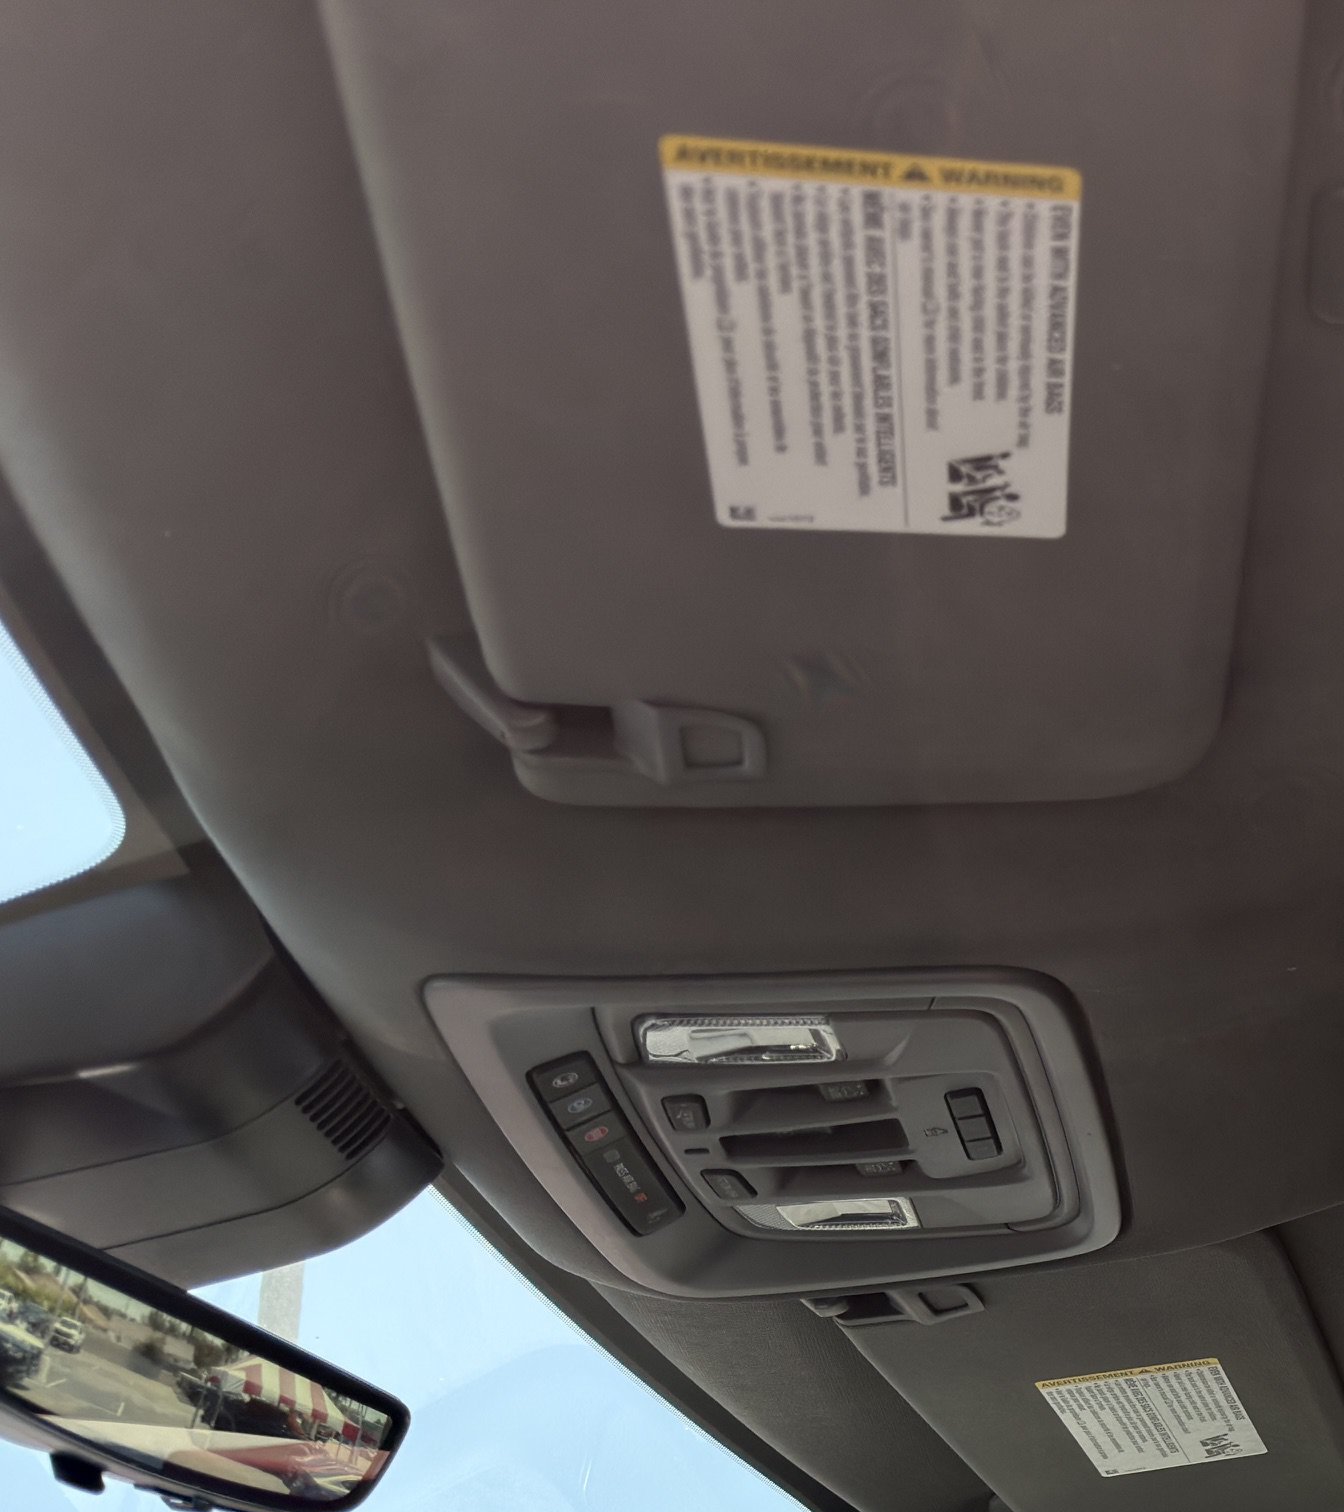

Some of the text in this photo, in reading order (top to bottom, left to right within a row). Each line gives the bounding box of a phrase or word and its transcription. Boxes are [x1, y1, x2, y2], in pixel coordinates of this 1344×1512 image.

[673, 144, 1064, 192] AVERTISSEMENT WARNING
[866, 270, 887, 296] DES
[868, 299, 889, 331] SACS
[1045, 205, 1072, 414] EVEN WITH ADVANCED AIR BAGS
[870, 336, 893, 409] GONFLABLES
[875, 412, 897, 487] INTELLIGENTS
[1039, 1370, 1134, 1387] AVERTISSEMENT
[1153, 1359, 1210, 1371] WARNING
